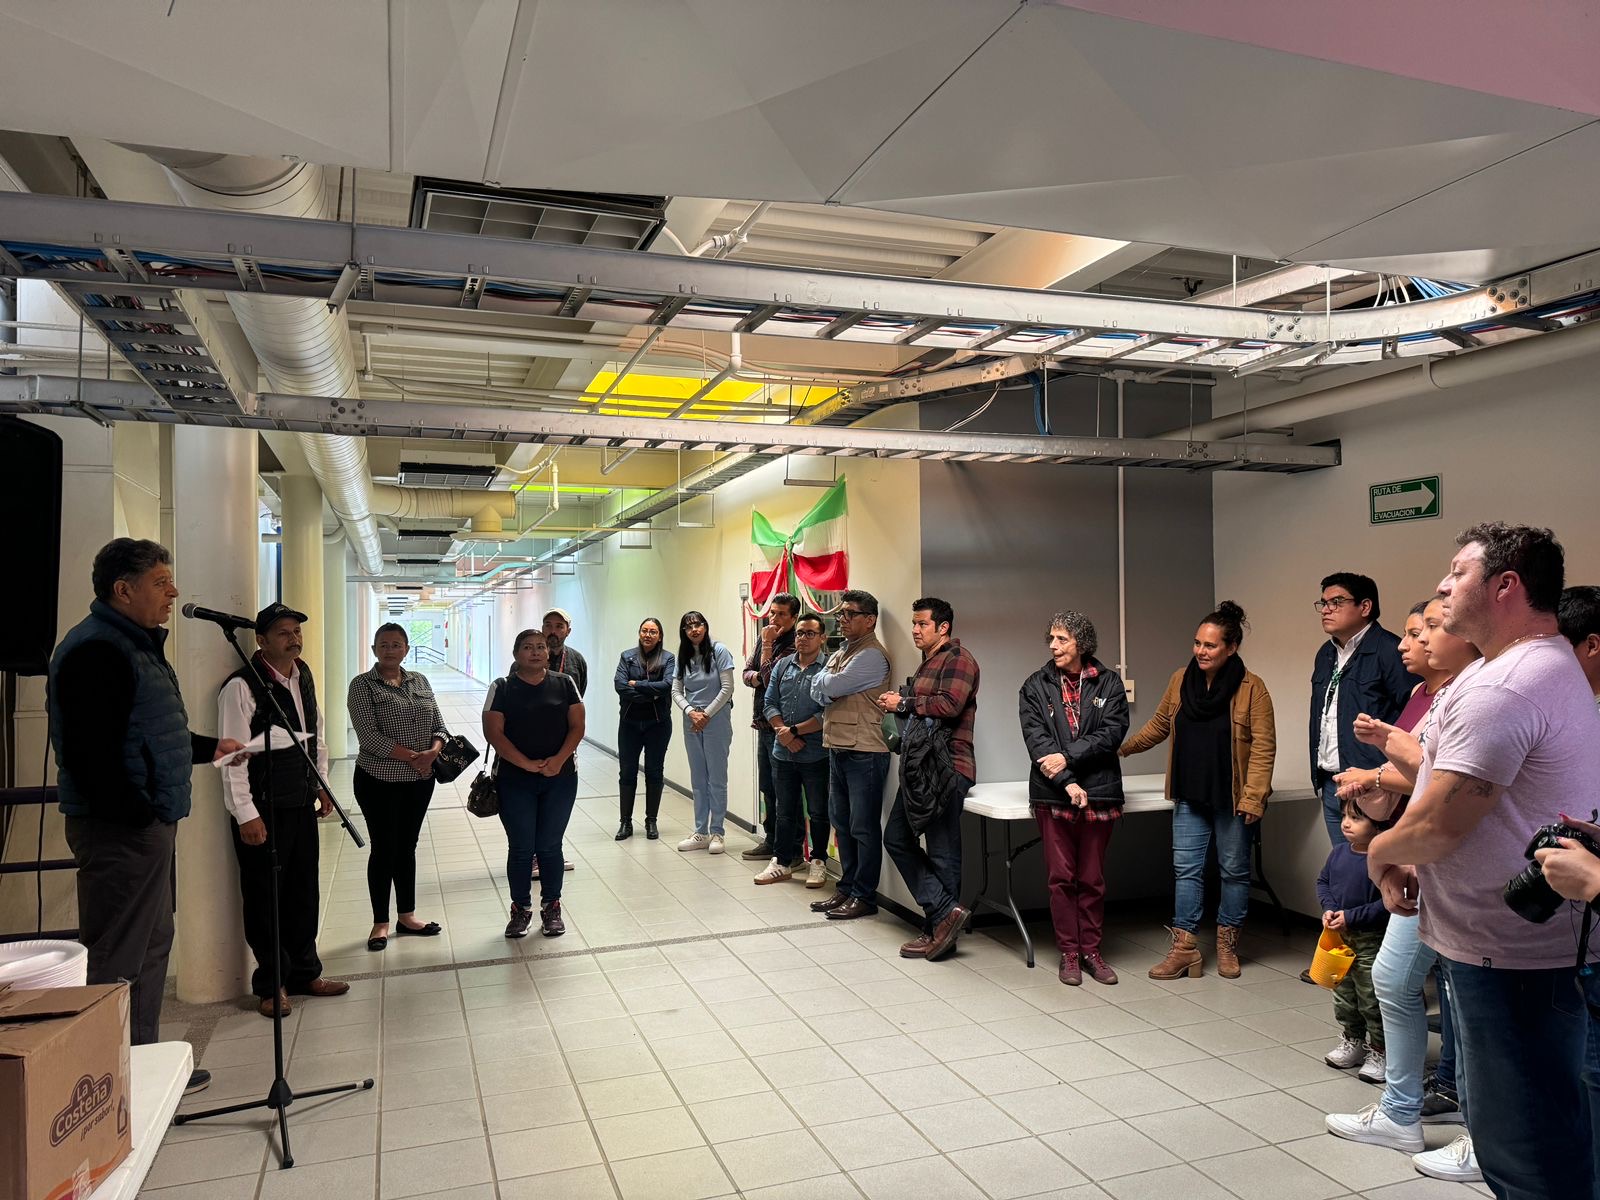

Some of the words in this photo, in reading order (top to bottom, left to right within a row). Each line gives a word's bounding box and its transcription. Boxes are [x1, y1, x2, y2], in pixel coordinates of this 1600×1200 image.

[1373, 487, 1391, 496] RUTA
[1392, 485, 1402, 493] DE
[1374, 509, 1415, 520] EVACUACION
[77, 1084, 88, 1102] La
[56, 1084, 107, 1137] Costeña
